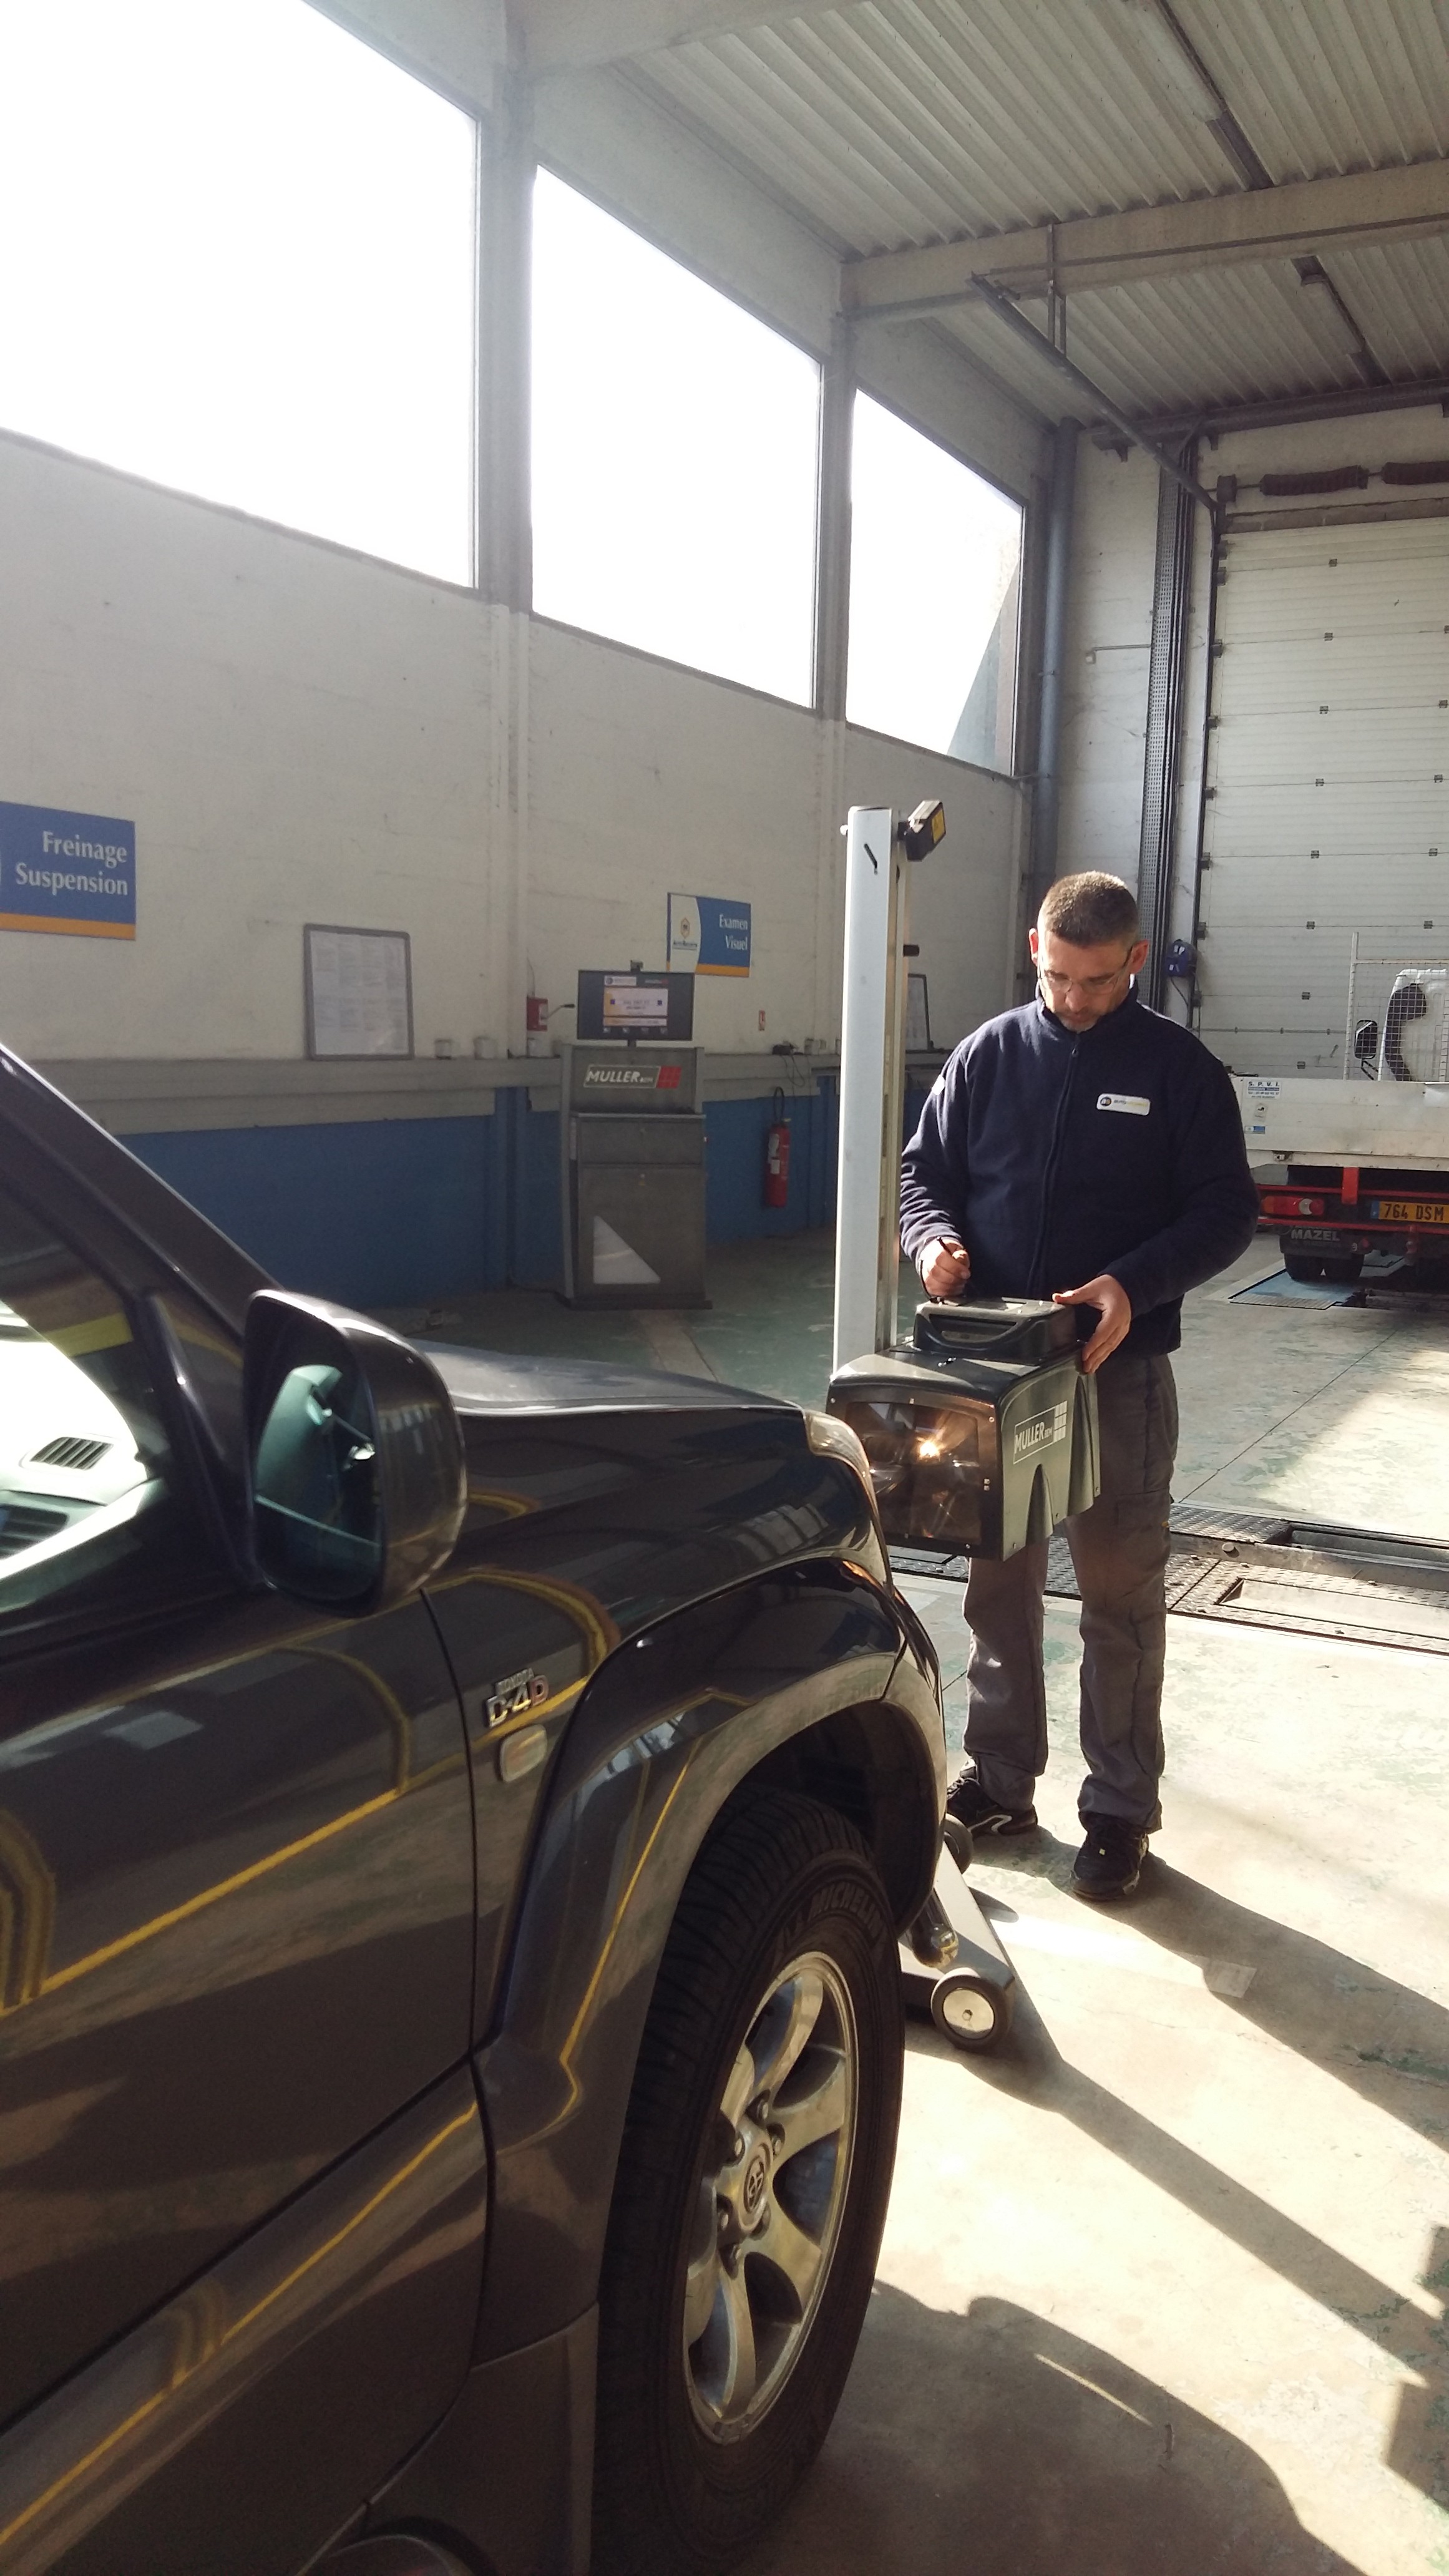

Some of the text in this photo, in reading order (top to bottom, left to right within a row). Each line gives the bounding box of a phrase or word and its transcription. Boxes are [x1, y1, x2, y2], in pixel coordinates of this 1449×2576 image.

[42, 830, 127, 869] Freinage
[16, 862, 128, 896] Suspension
[719, 914, 748, 930] Examen
[725, 935, 748, 950] Visuel
[585, 1070, 641, 1083] MULLER
[1384, 1203, 1444, 1221] 764 DSM
[1290, 1229, 1341, 1242] MAZEL
[1014, 1422, 1045, 1455] MULLER
[807, 1881, 881, 1939] MICHELIN
